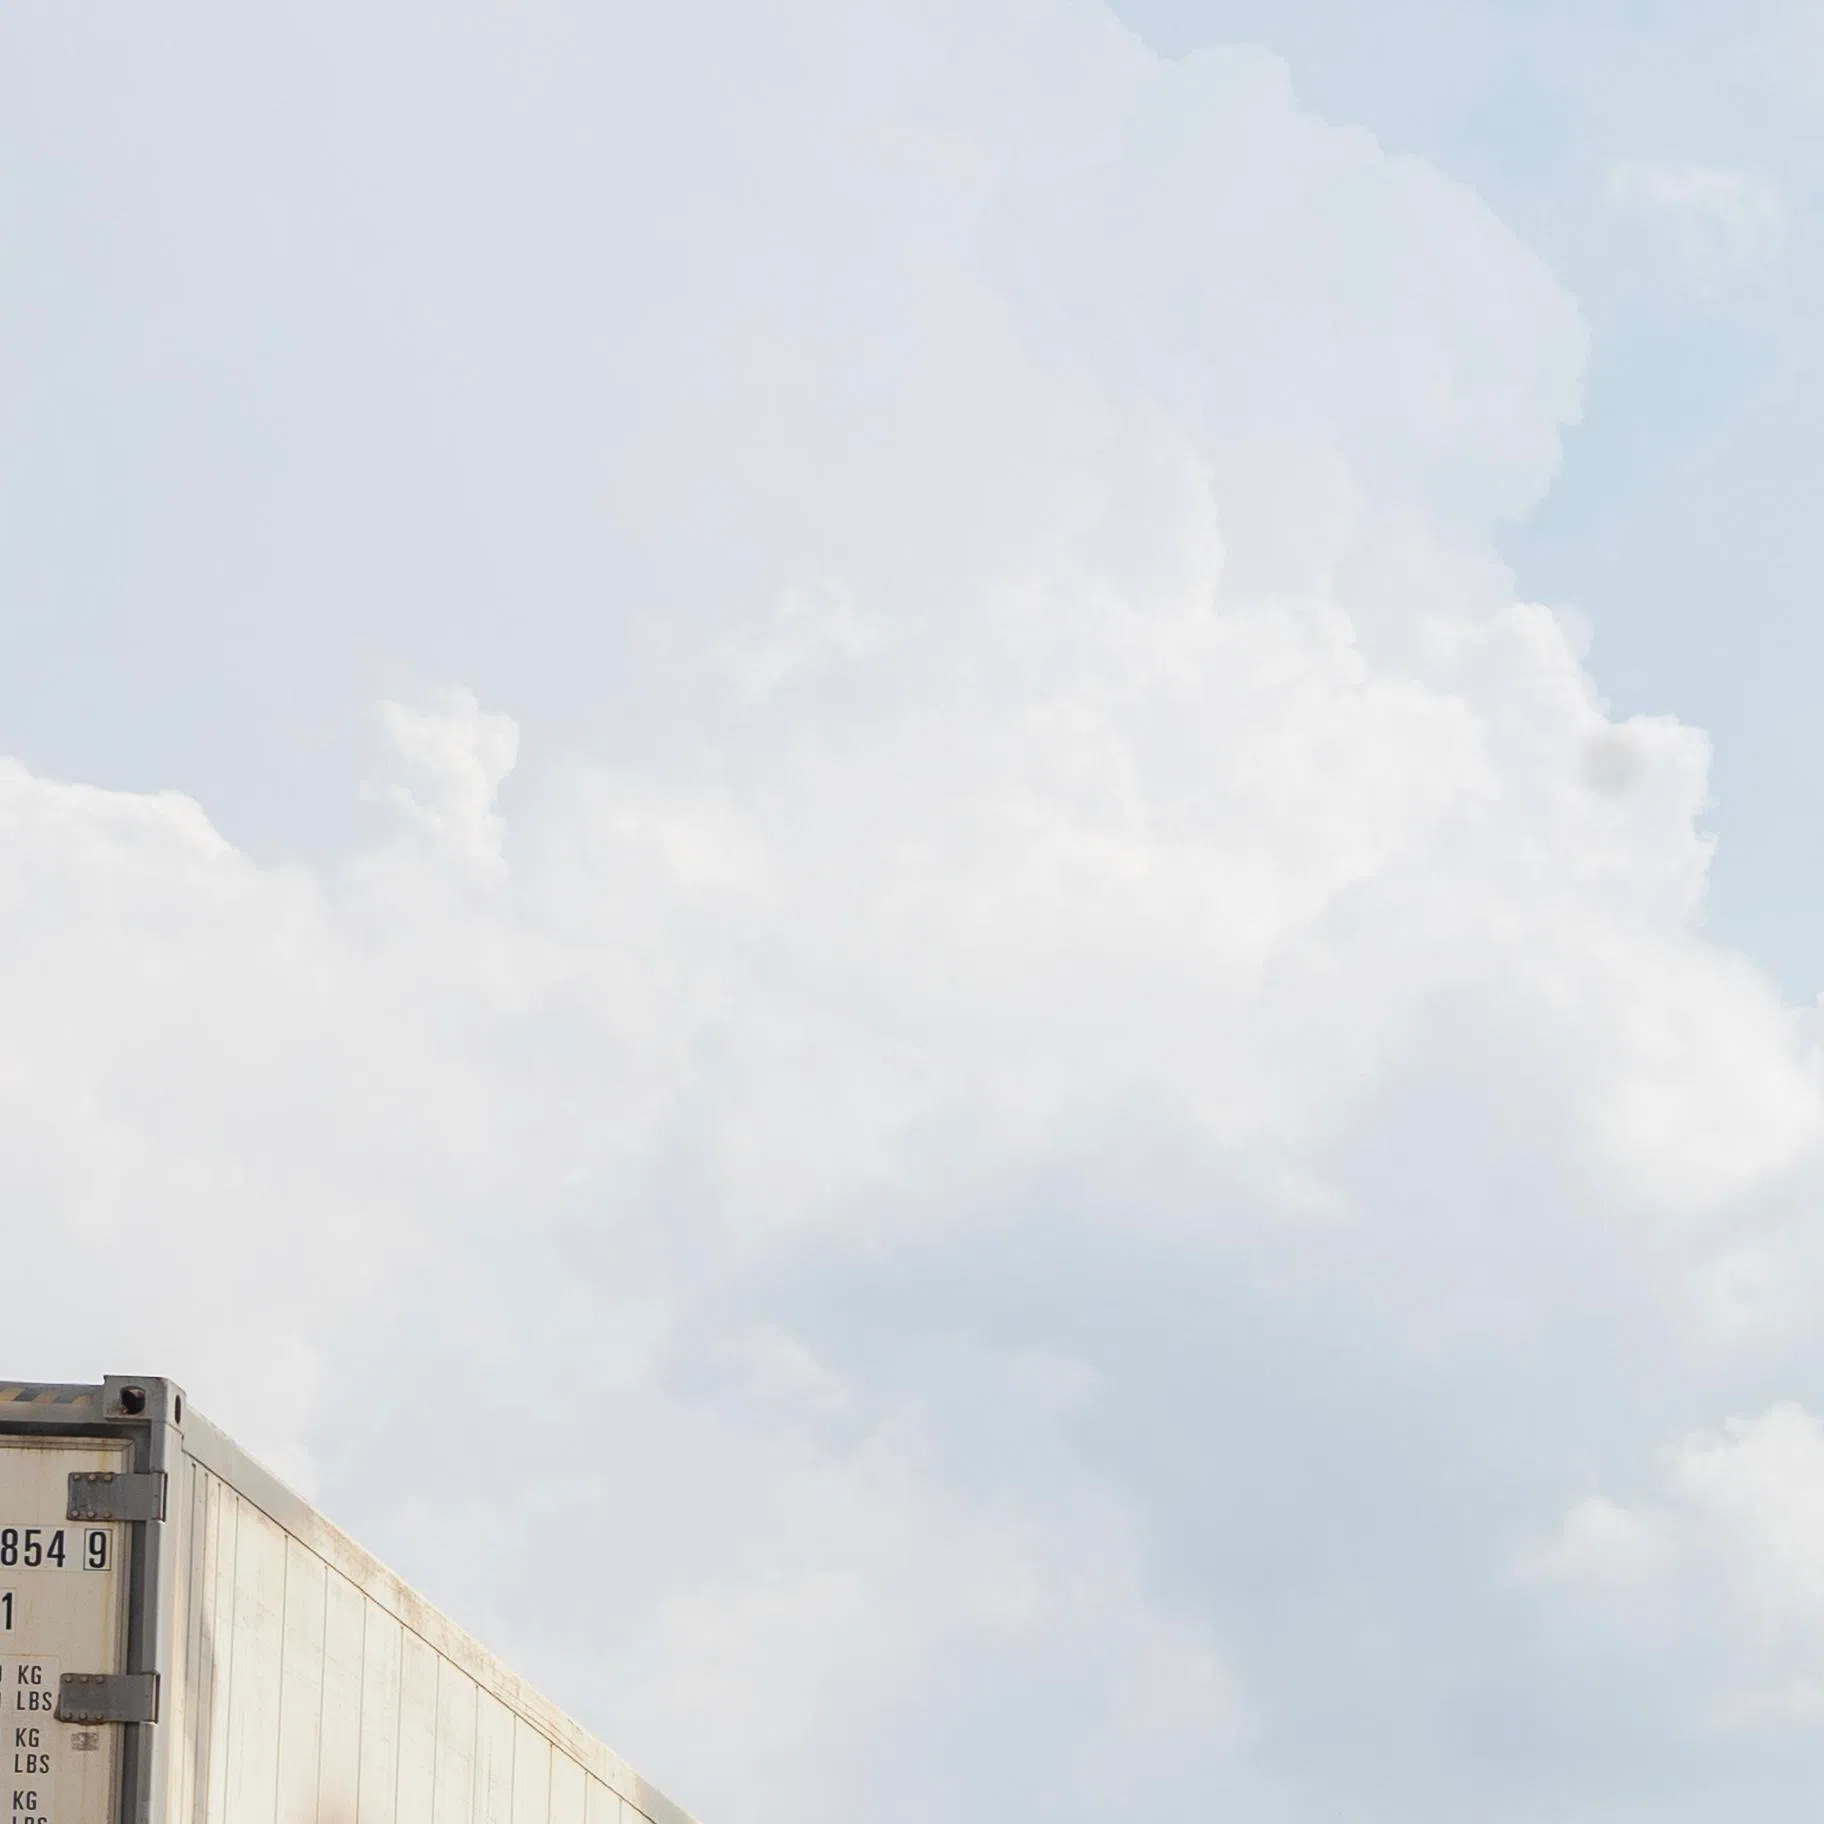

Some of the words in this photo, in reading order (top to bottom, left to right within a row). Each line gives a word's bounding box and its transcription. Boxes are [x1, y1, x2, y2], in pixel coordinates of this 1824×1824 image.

[89, 1531, 107, 1569] 9
[18, 1665, 42, 1685] KG
[16, 1691, 52, 1711] LBS
[15, 1728, 40, 1747] KG
[14, 1754, 50, 1774] LBS
[12, 1790, 37, 1811] KG
